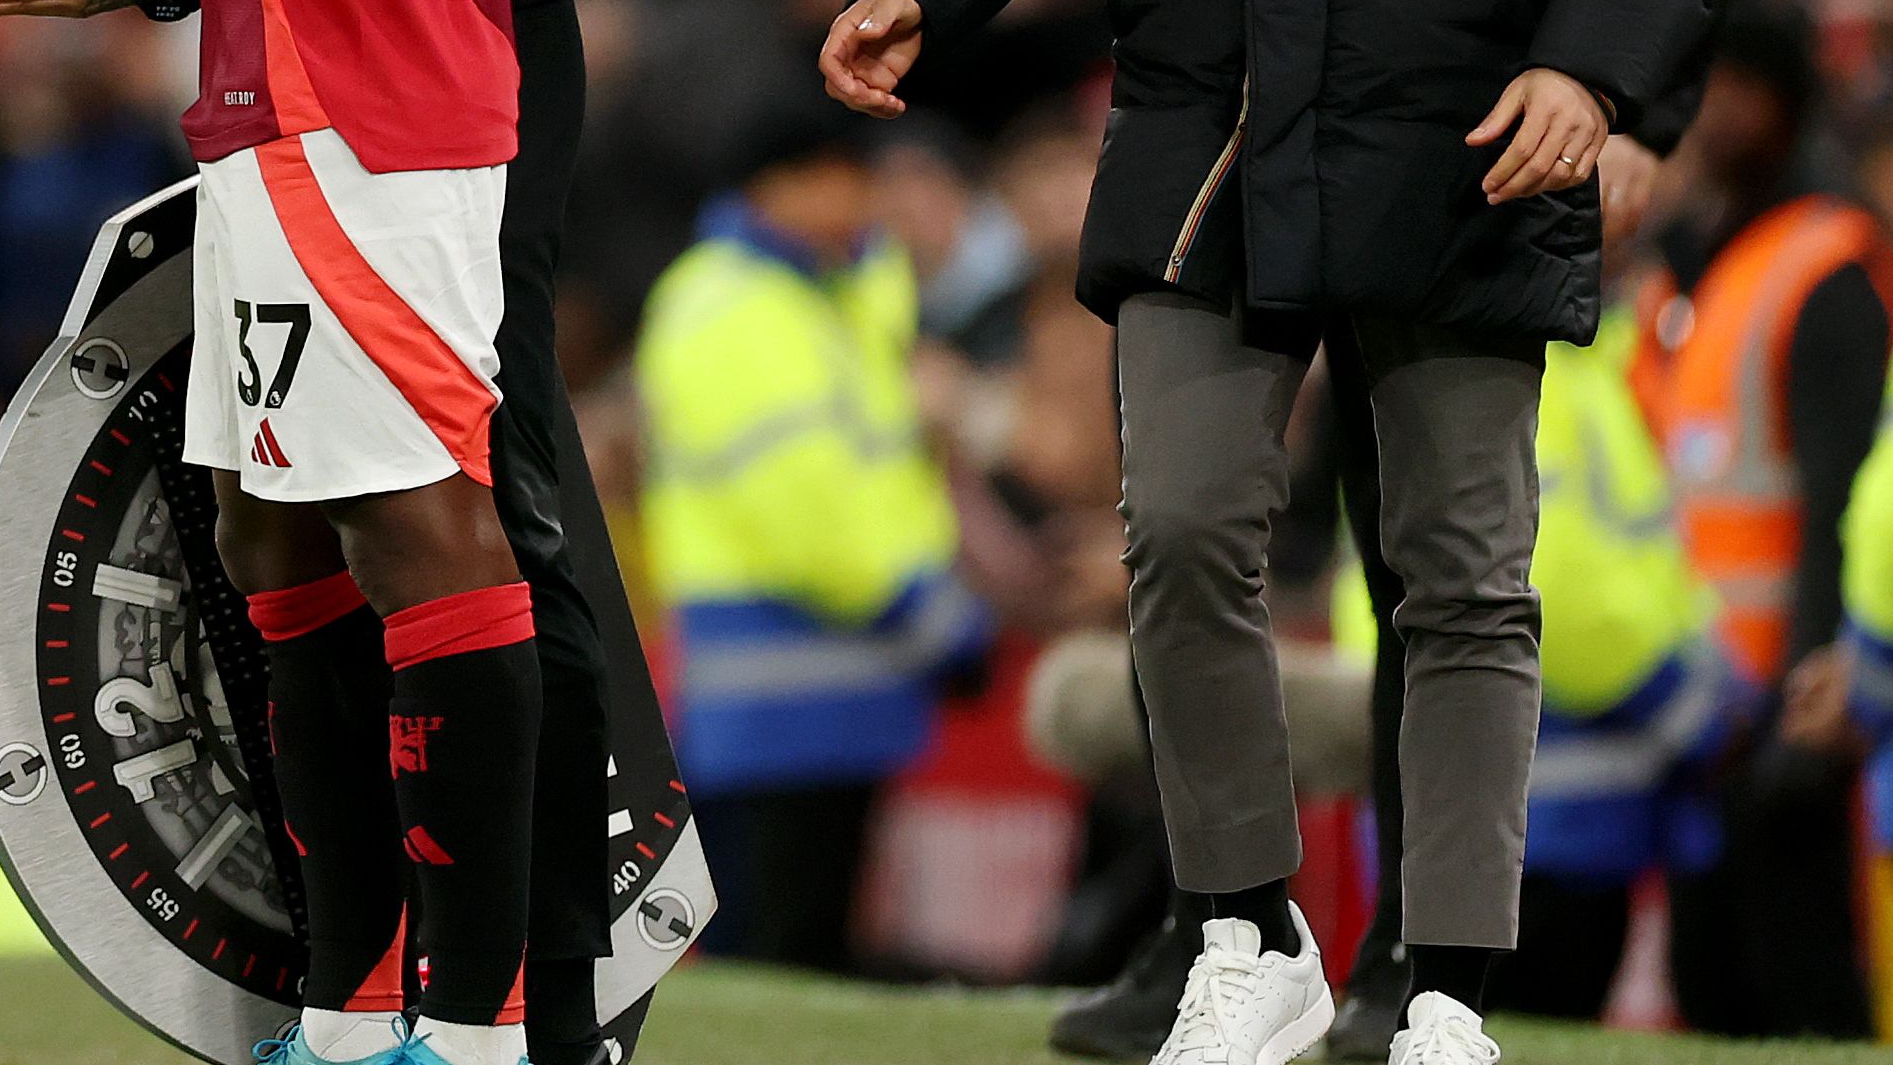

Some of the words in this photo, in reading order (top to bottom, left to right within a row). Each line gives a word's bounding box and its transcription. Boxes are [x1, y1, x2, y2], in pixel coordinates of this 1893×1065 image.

[234, 298, 312, 409] 37
[53, 551, 78, 587] 05
[93, 659, 198, 804] 12
[60, 733, 86, 769] 60
[613, 860, 642, 896] 40
[146, 887, 180, 922] 55
